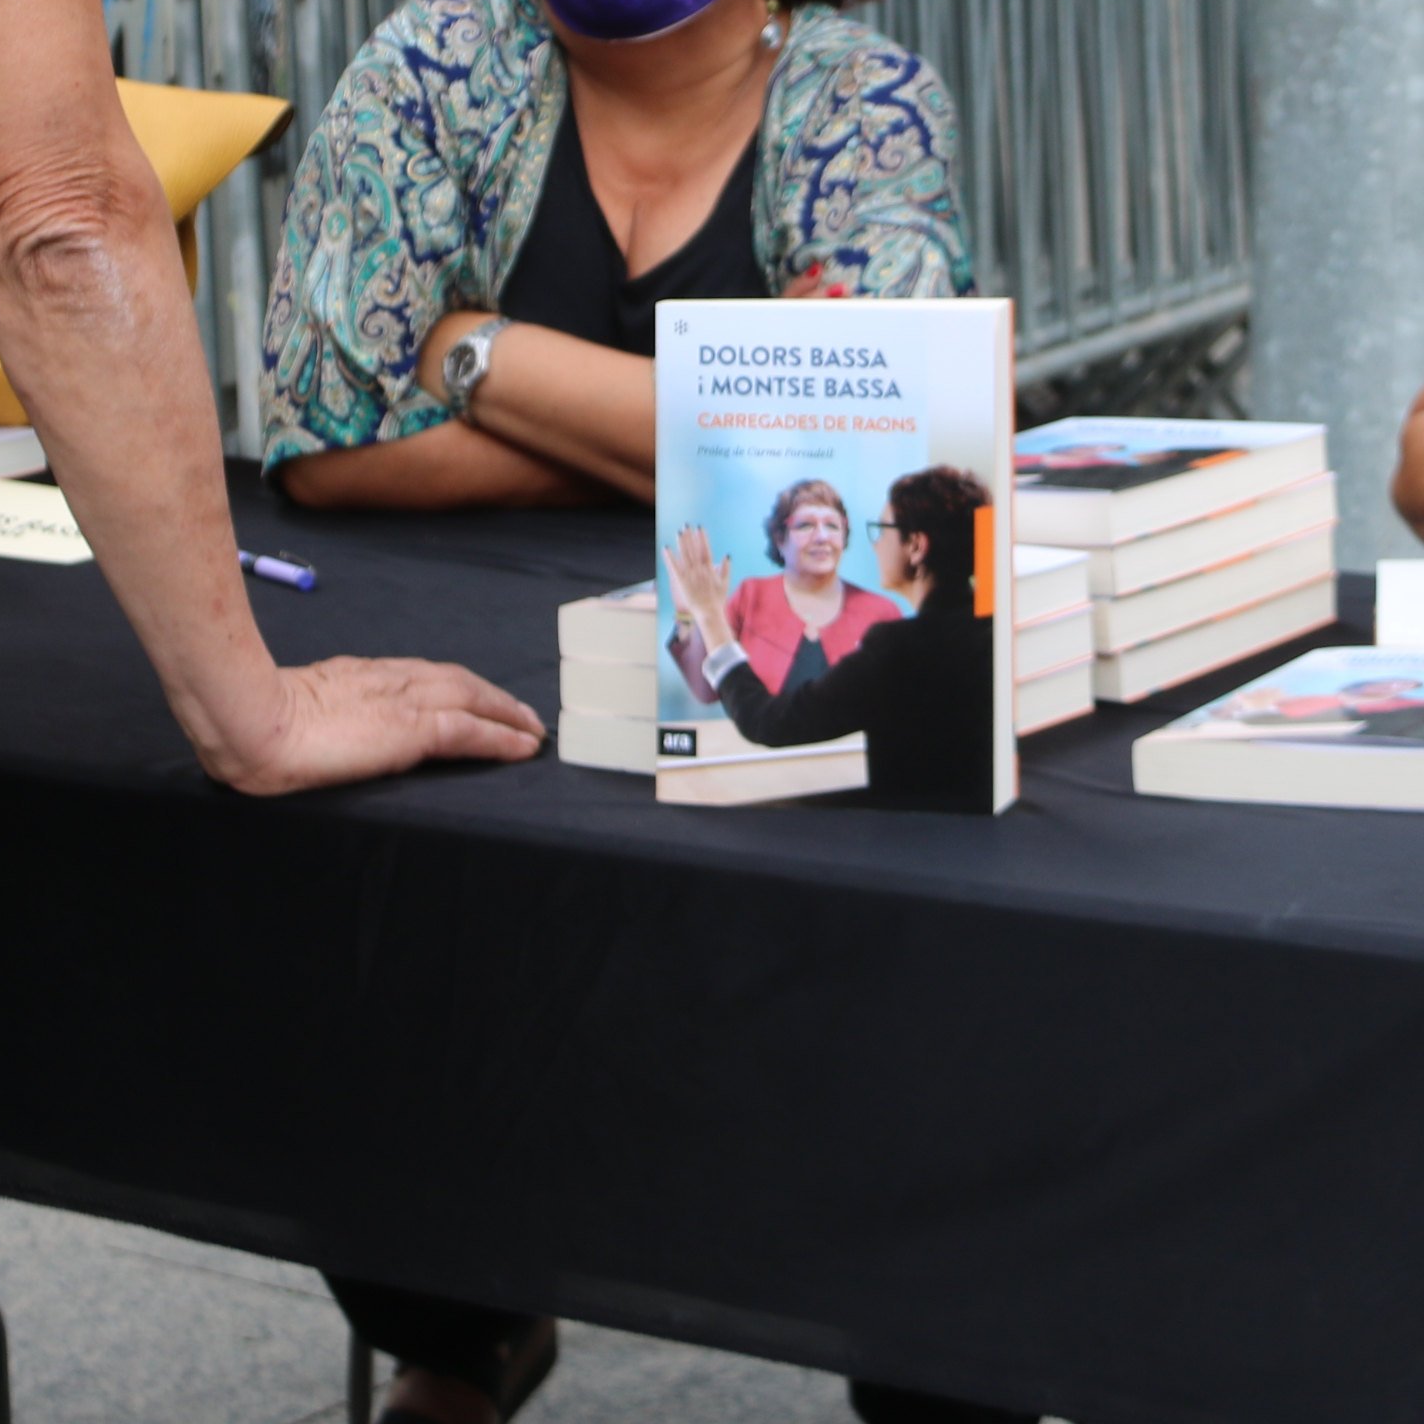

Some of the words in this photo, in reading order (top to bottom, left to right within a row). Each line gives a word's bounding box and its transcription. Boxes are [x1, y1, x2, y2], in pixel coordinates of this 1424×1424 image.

[698, 345, 801, 367] DOLORS
[810, 347, 887, 368] BASSA
[711, 376, 815, 397] MONTSE
[824, 377, 901, 399] BASSA
[697, 412, 819, 431] CARREGADES
[823, 414, 848, 432] DE
[852, 415, 916, 433] RAONS
